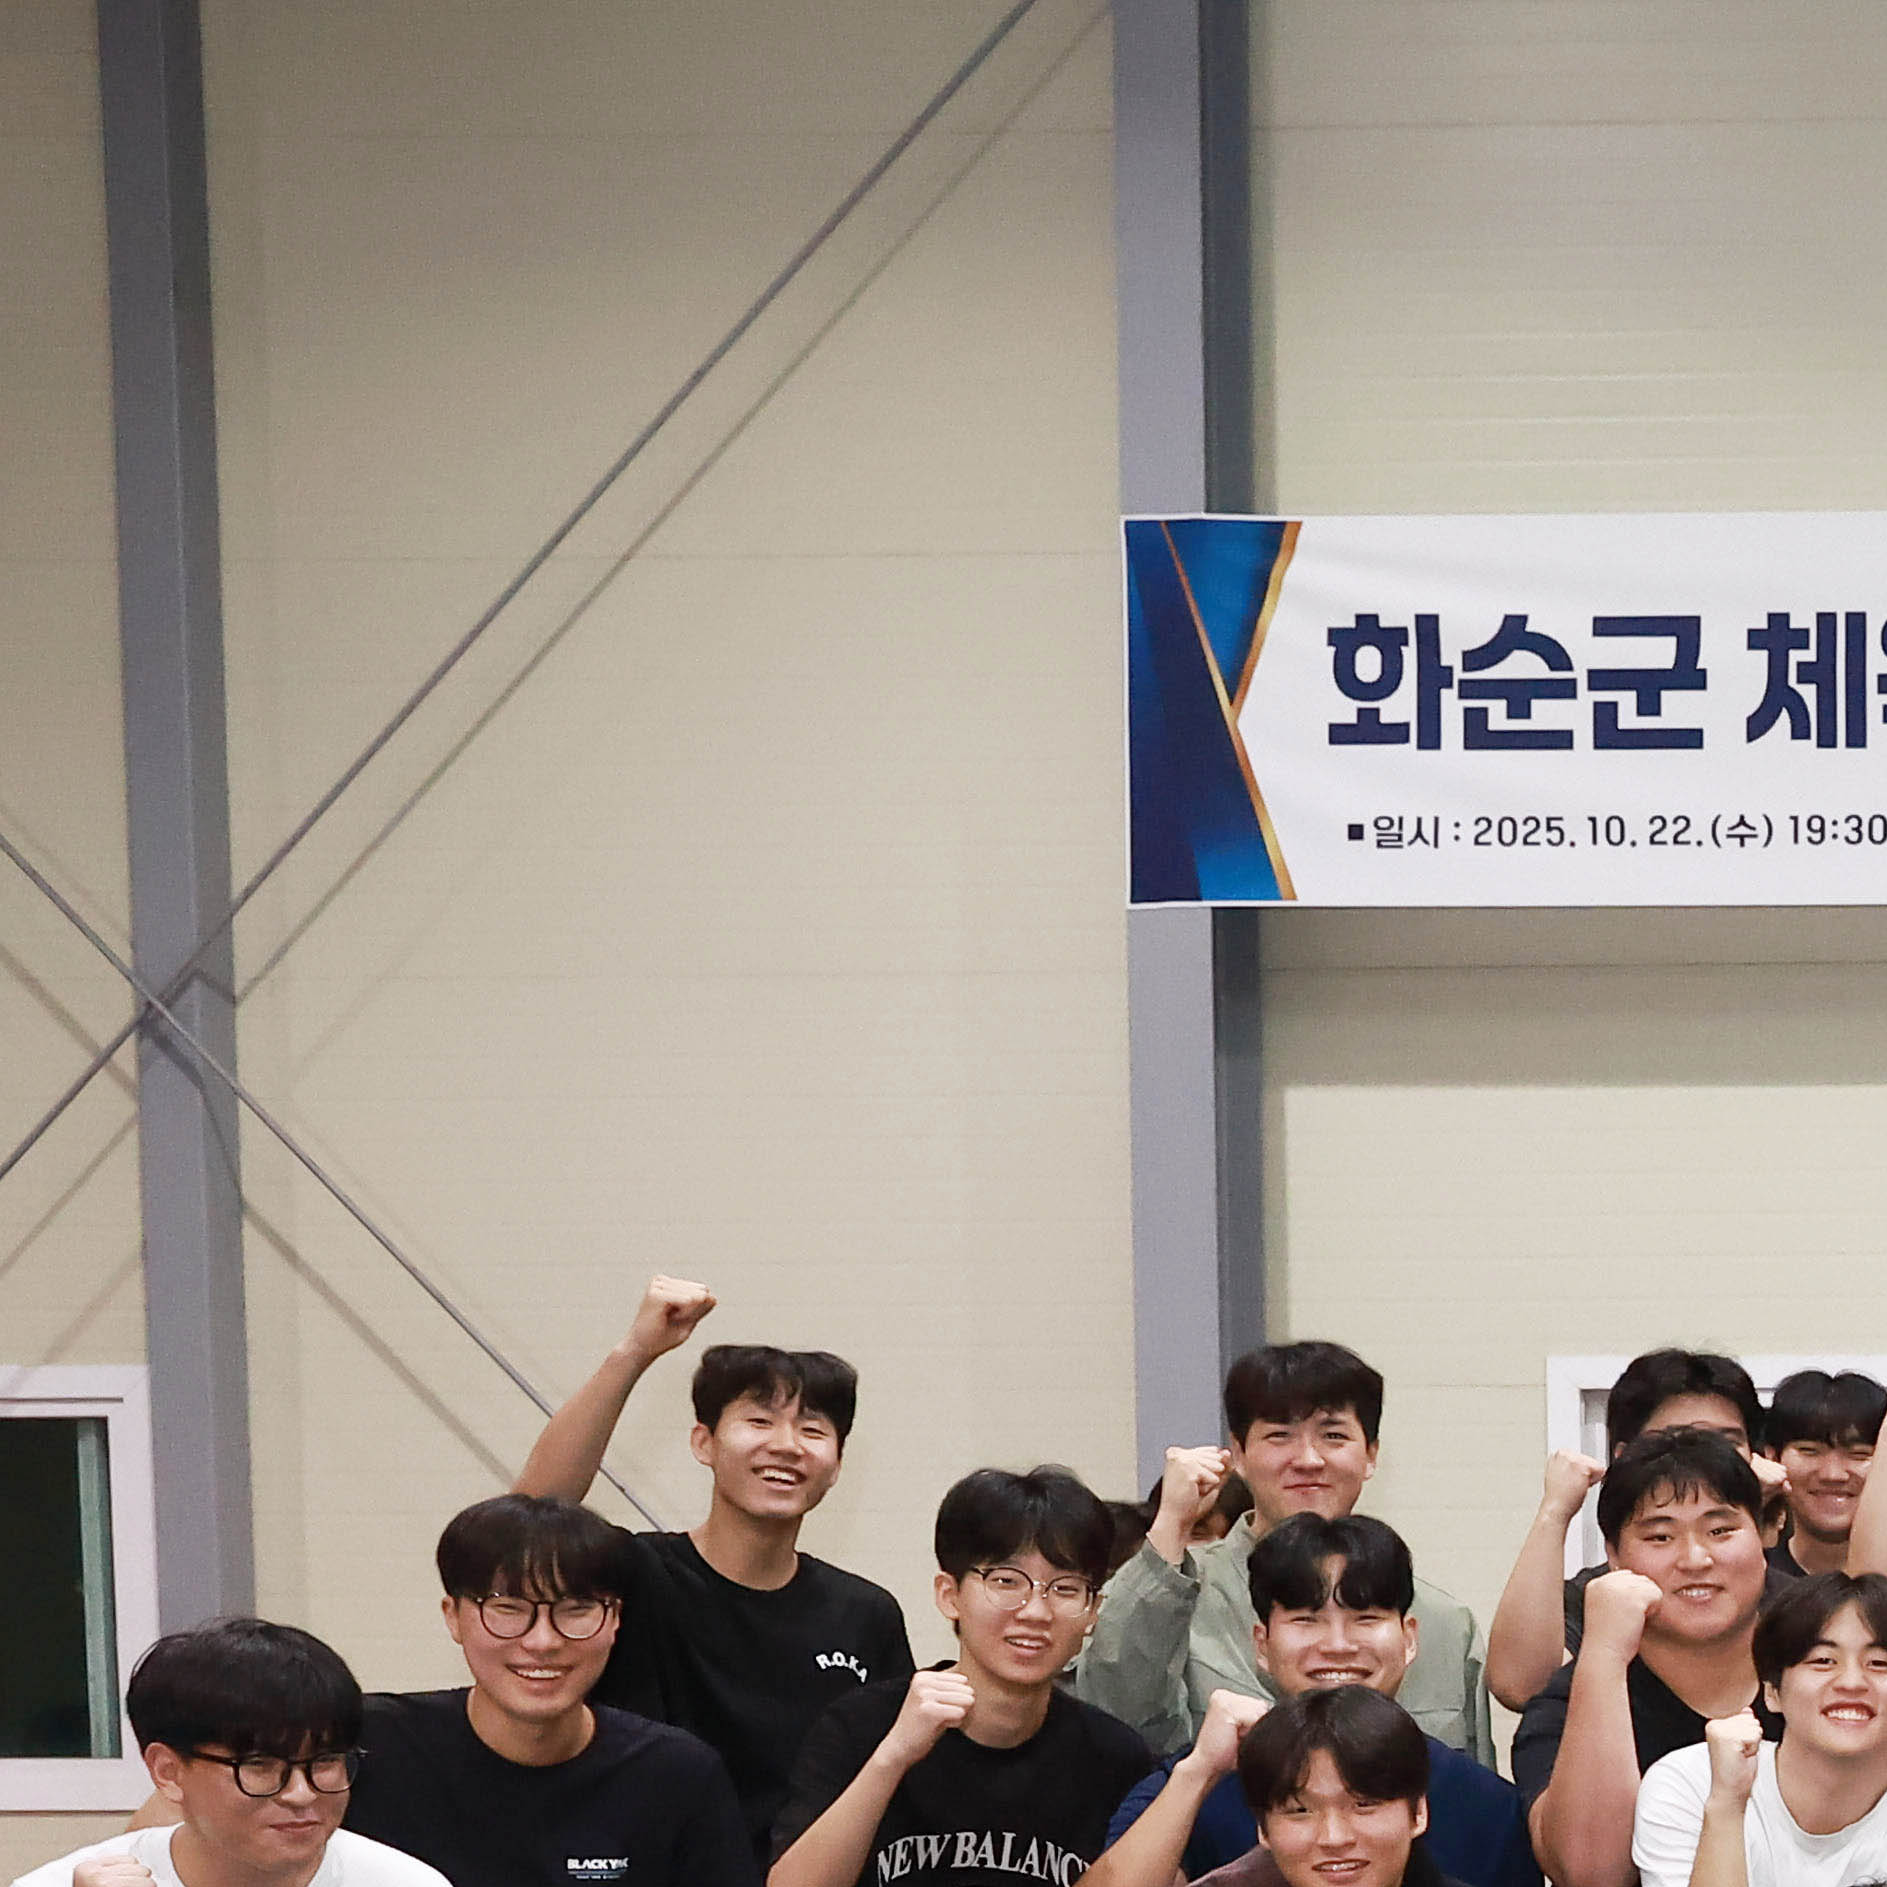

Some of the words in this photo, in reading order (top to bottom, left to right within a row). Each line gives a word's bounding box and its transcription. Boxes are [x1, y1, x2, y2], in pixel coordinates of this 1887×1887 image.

[1327, 613, 1707, 751] 화순군
[1373, 816, 1439, 849] 일시
[1789, 814, 1887, 846] 19:30
